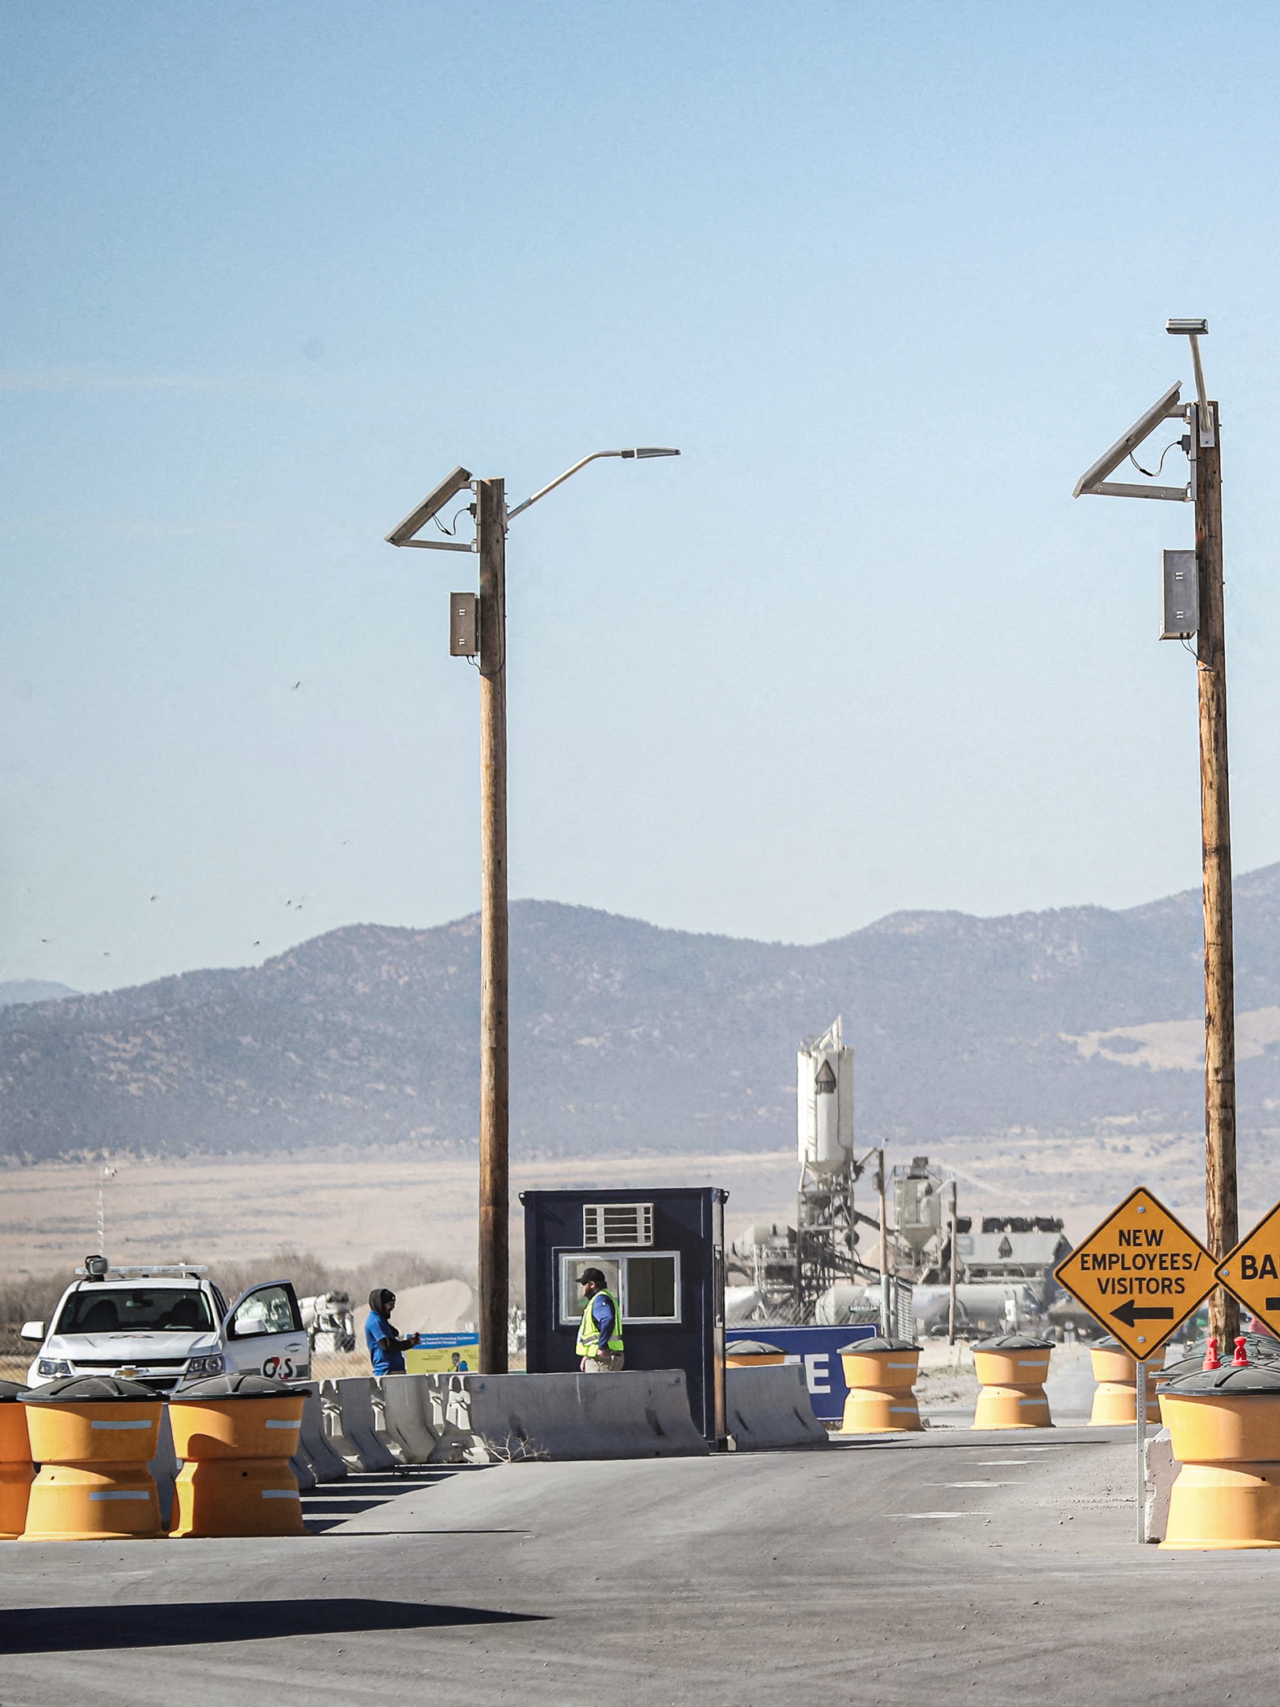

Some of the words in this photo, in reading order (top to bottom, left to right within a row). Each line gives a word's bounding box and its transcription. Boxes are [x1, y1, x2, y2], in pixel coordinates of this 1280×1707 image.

[1118, 1229, 1164, 1247] NEW
[1080, 1252, 1202, 1272] EMPLOYEES/
[1097, 1277, 1186, 1295] VISITORS
